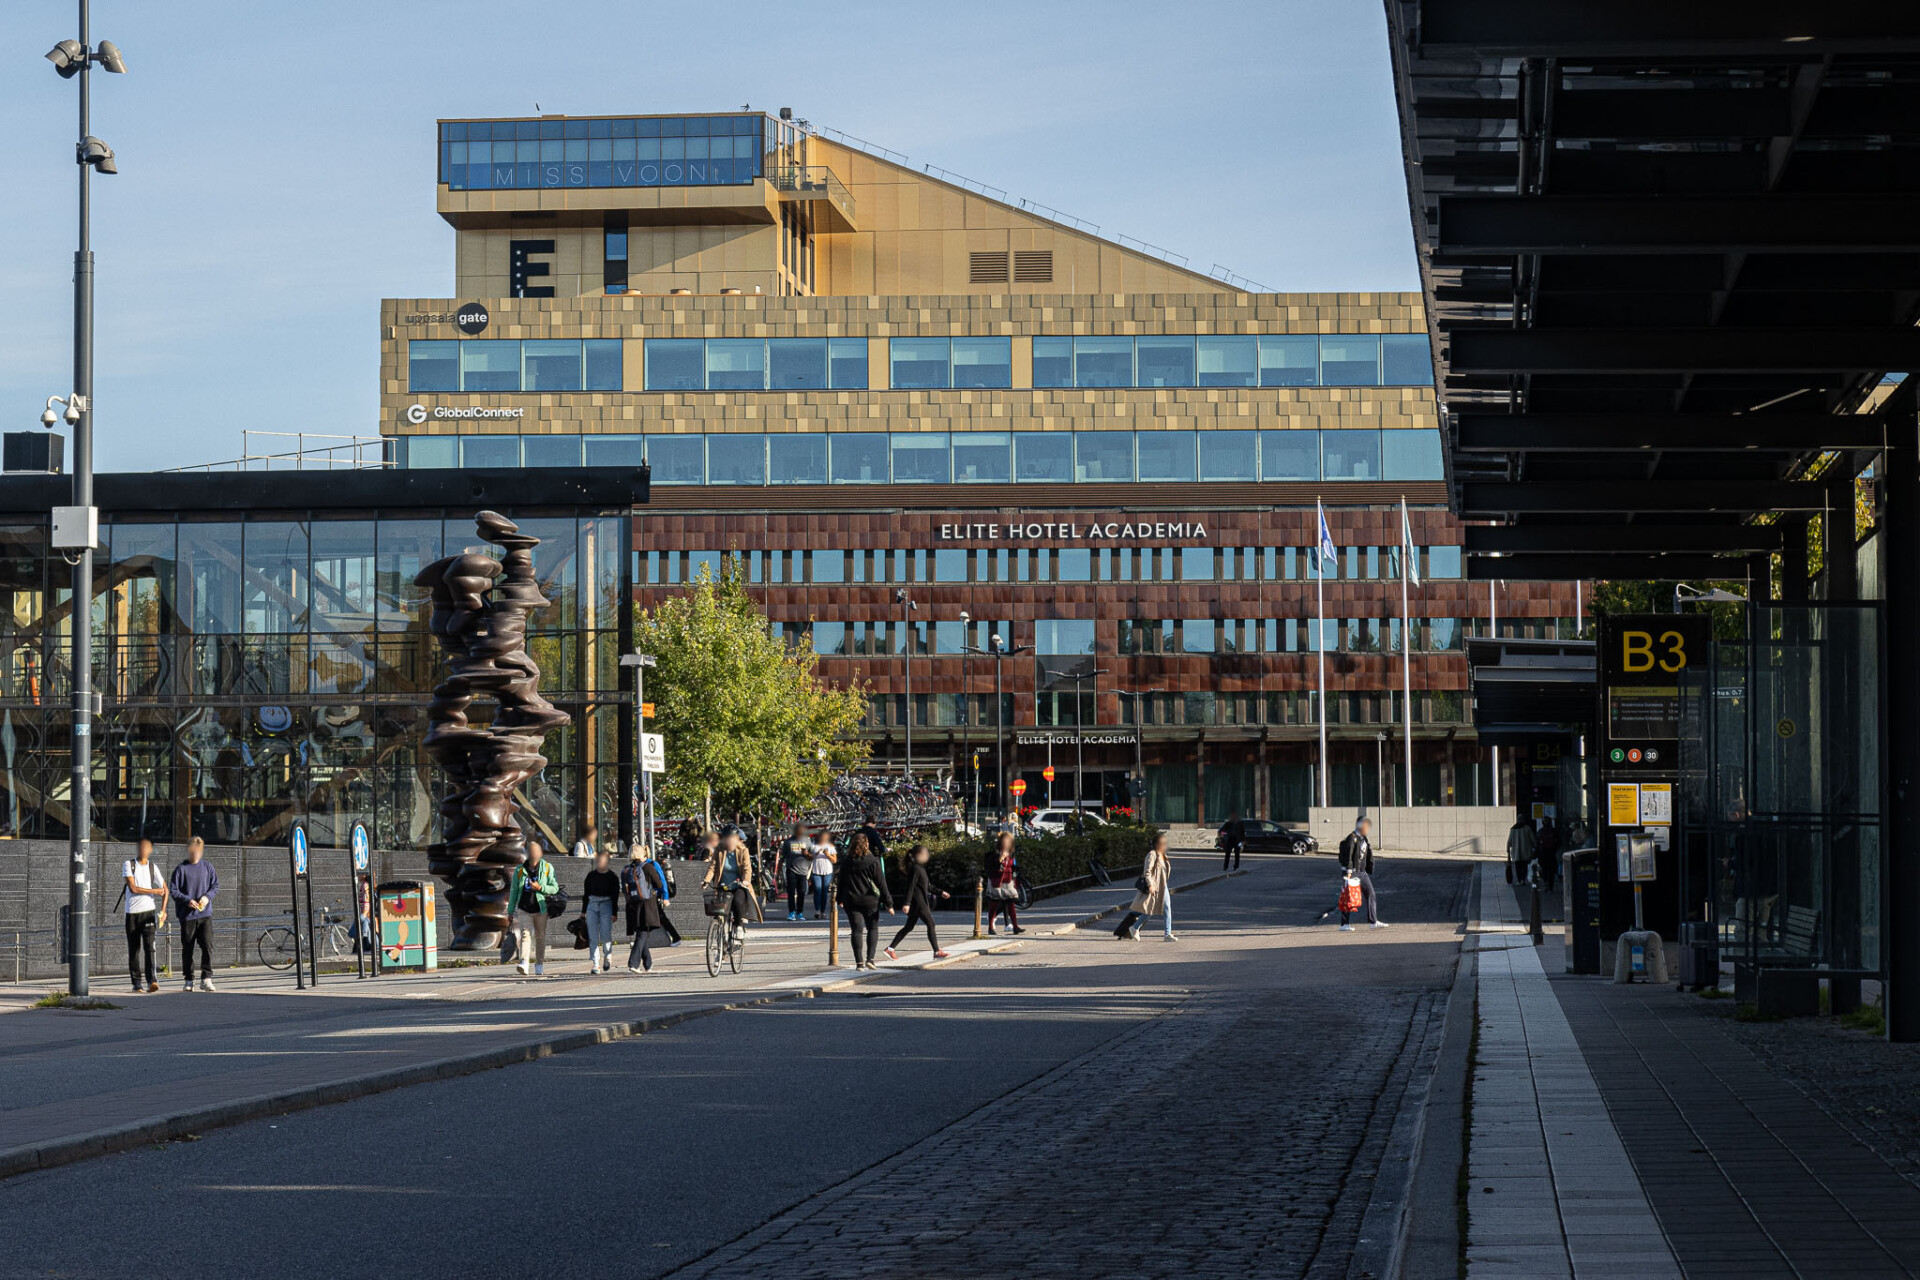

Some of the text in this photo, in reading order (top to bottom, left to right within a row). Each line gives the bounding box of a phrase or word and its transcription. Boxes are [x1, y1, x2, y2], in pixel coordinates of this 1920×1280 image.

[496, 164, 706, 185] MISS VOON
[509, 239, 555, 298] E
[405, 312, 488, 325] uppsala gate
[407, 404, 524, 424] G GlobalConnect
[941, 522, 1208, 539] ELITE HOTEL ACADEMIA
[1622, 630, 1687, 672] B3
[1018, 736, 1045, 745] ELITE
[1083, 735, 1137, 744] ACADEMIA
[1614, 751, 1657, 759] 3 8 30
